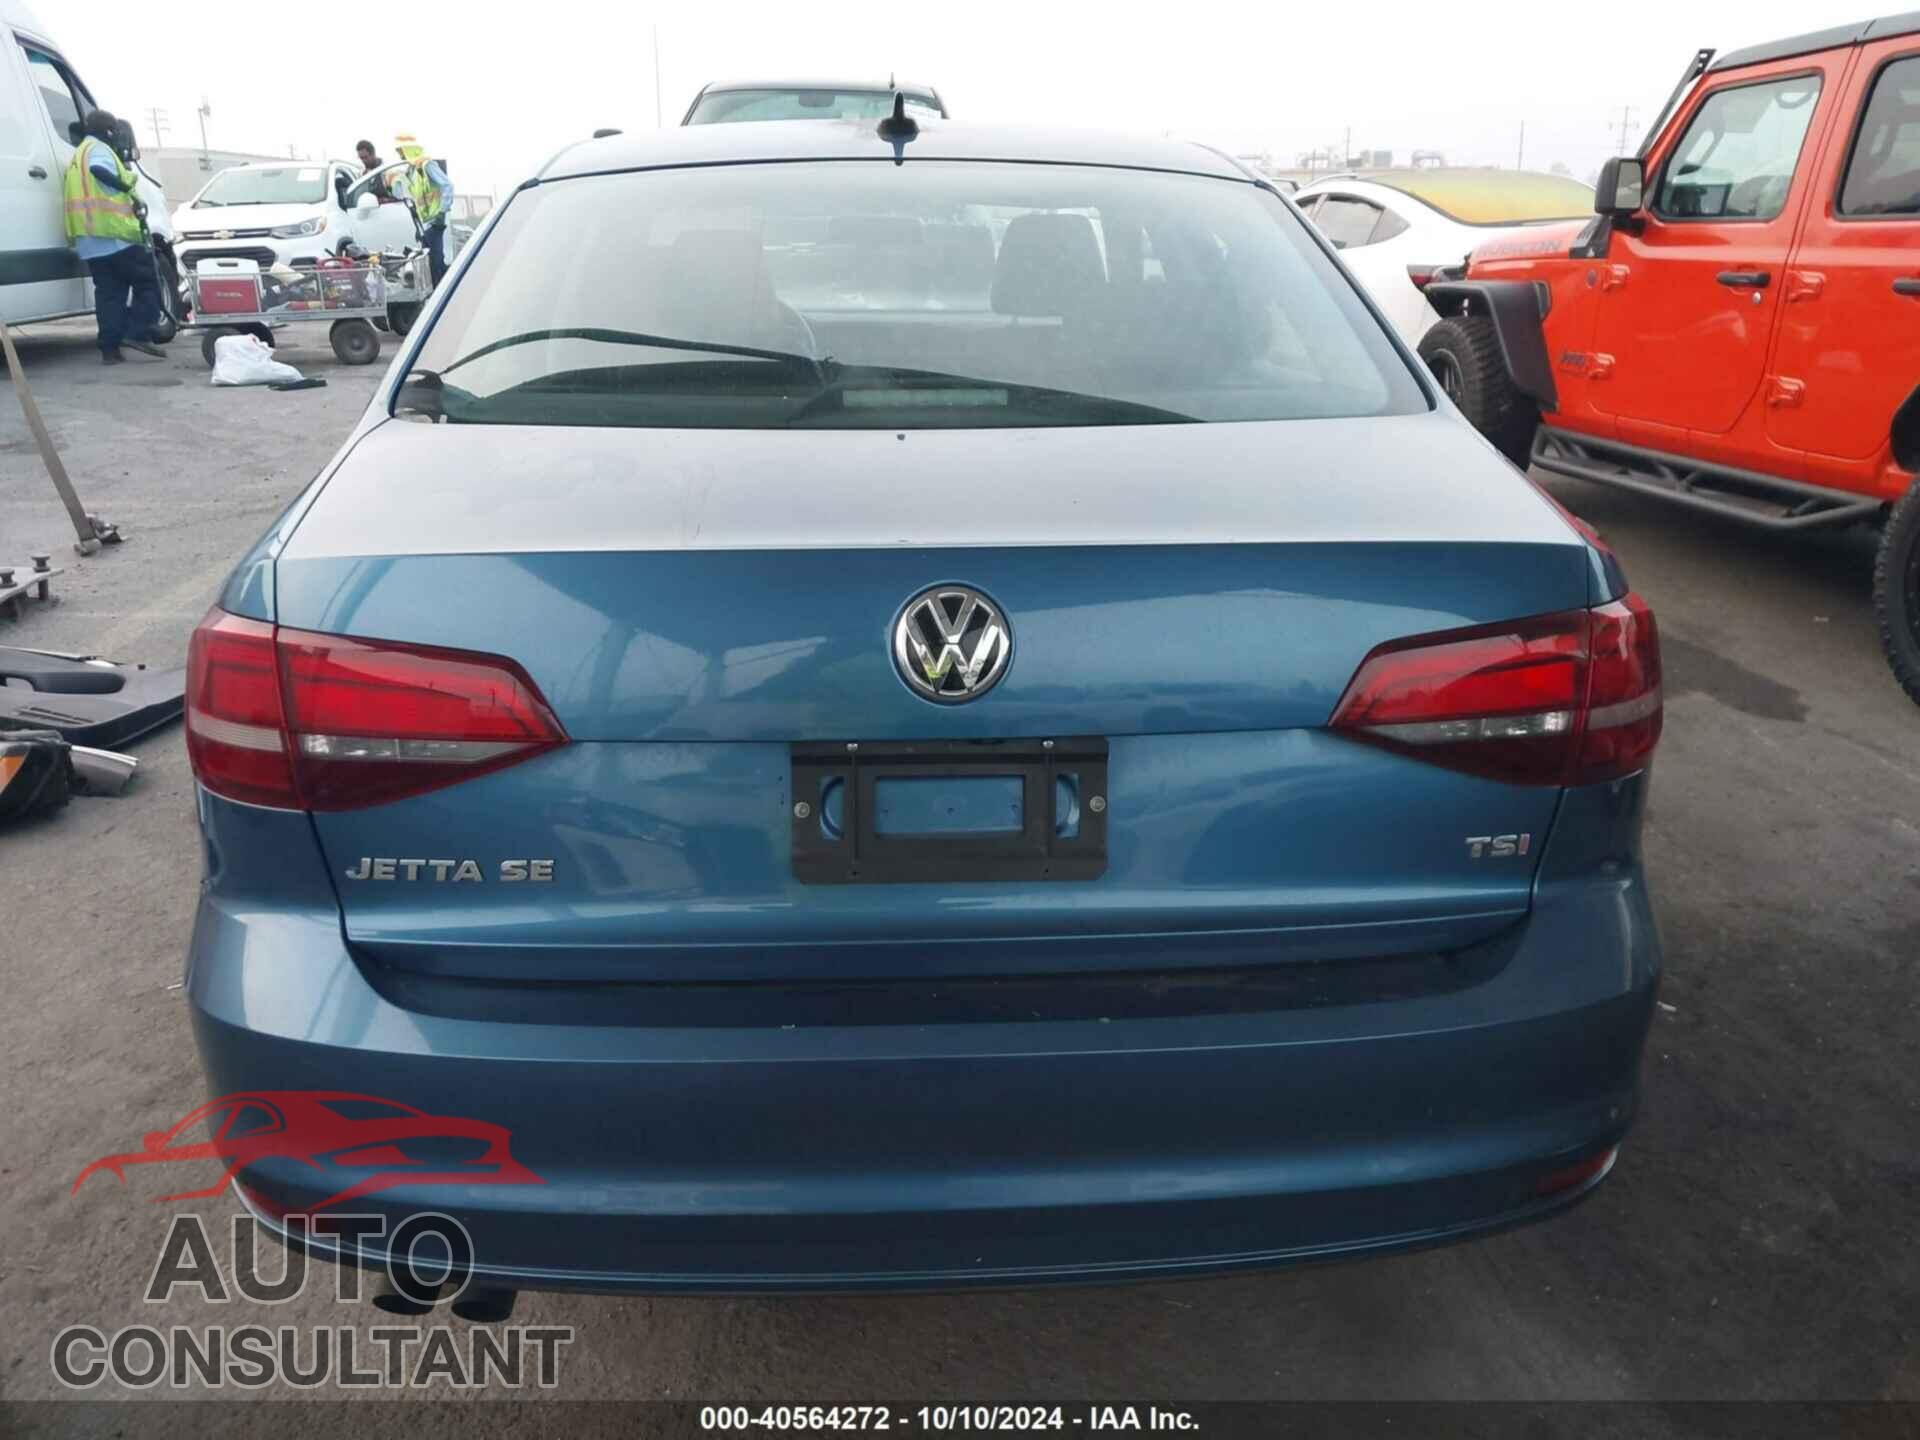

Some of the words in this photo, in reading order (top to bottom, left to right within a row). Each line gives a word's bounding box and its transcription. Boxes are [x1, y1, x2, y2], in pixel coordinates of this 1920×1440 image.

[1465, 833, 1531, 857] TSI
[345, 857, 483, 881] JETTA
[500, 859, 555, 881] SE
